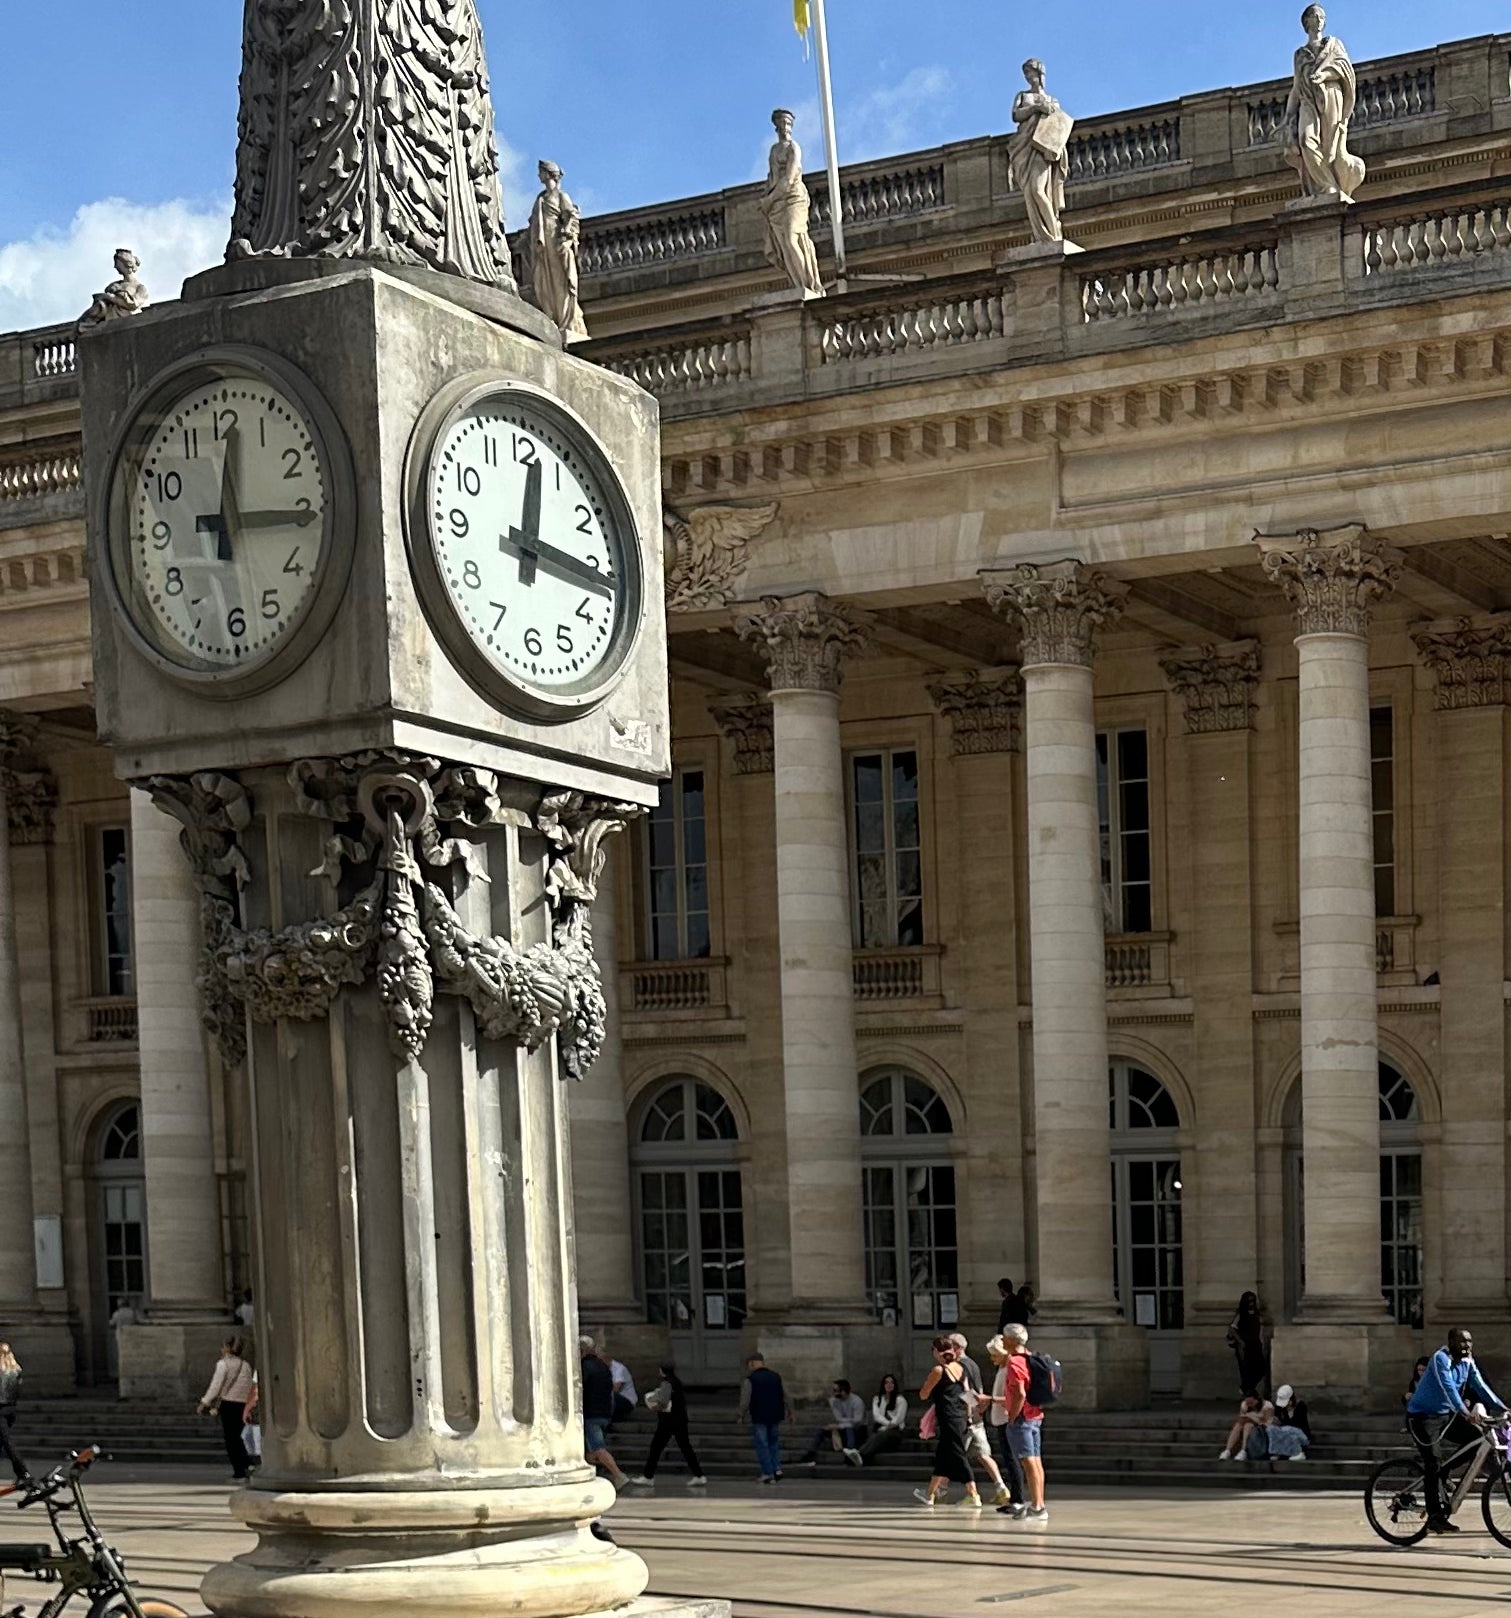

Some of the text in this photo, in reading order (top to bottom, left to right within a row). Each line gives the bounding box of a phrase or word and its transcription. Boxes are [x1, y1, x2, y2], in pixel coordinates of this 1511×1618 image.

[184, 428, 198, 460] 11
[259, 417, 265, 447] 1
[281, 448, 303, 480] 2
[484, 434, 498, 468] 11
[512, 432, 537, 467] 12
[157, 471, 183, 503] 10
[457, 461, 481, 497] 10
[556, 462, 561, 491] 1
[449, 508, 470, 538] 9
[574, 504, 593, 536] 2
[152, 521, 171, 550] 9
[283, 546, 304, 577] 4
[463, 560, 482, 590] 8
[165, 567, 184, 597] 8
[262, 589, 281, 619] 5
[489, 601, 507, 631] 7
[575, 597, 594, 625] 4
[228, 607, 246, 637] 6
[523, 627, 543, 656] 6
[556, 623, 574, 653] 5
